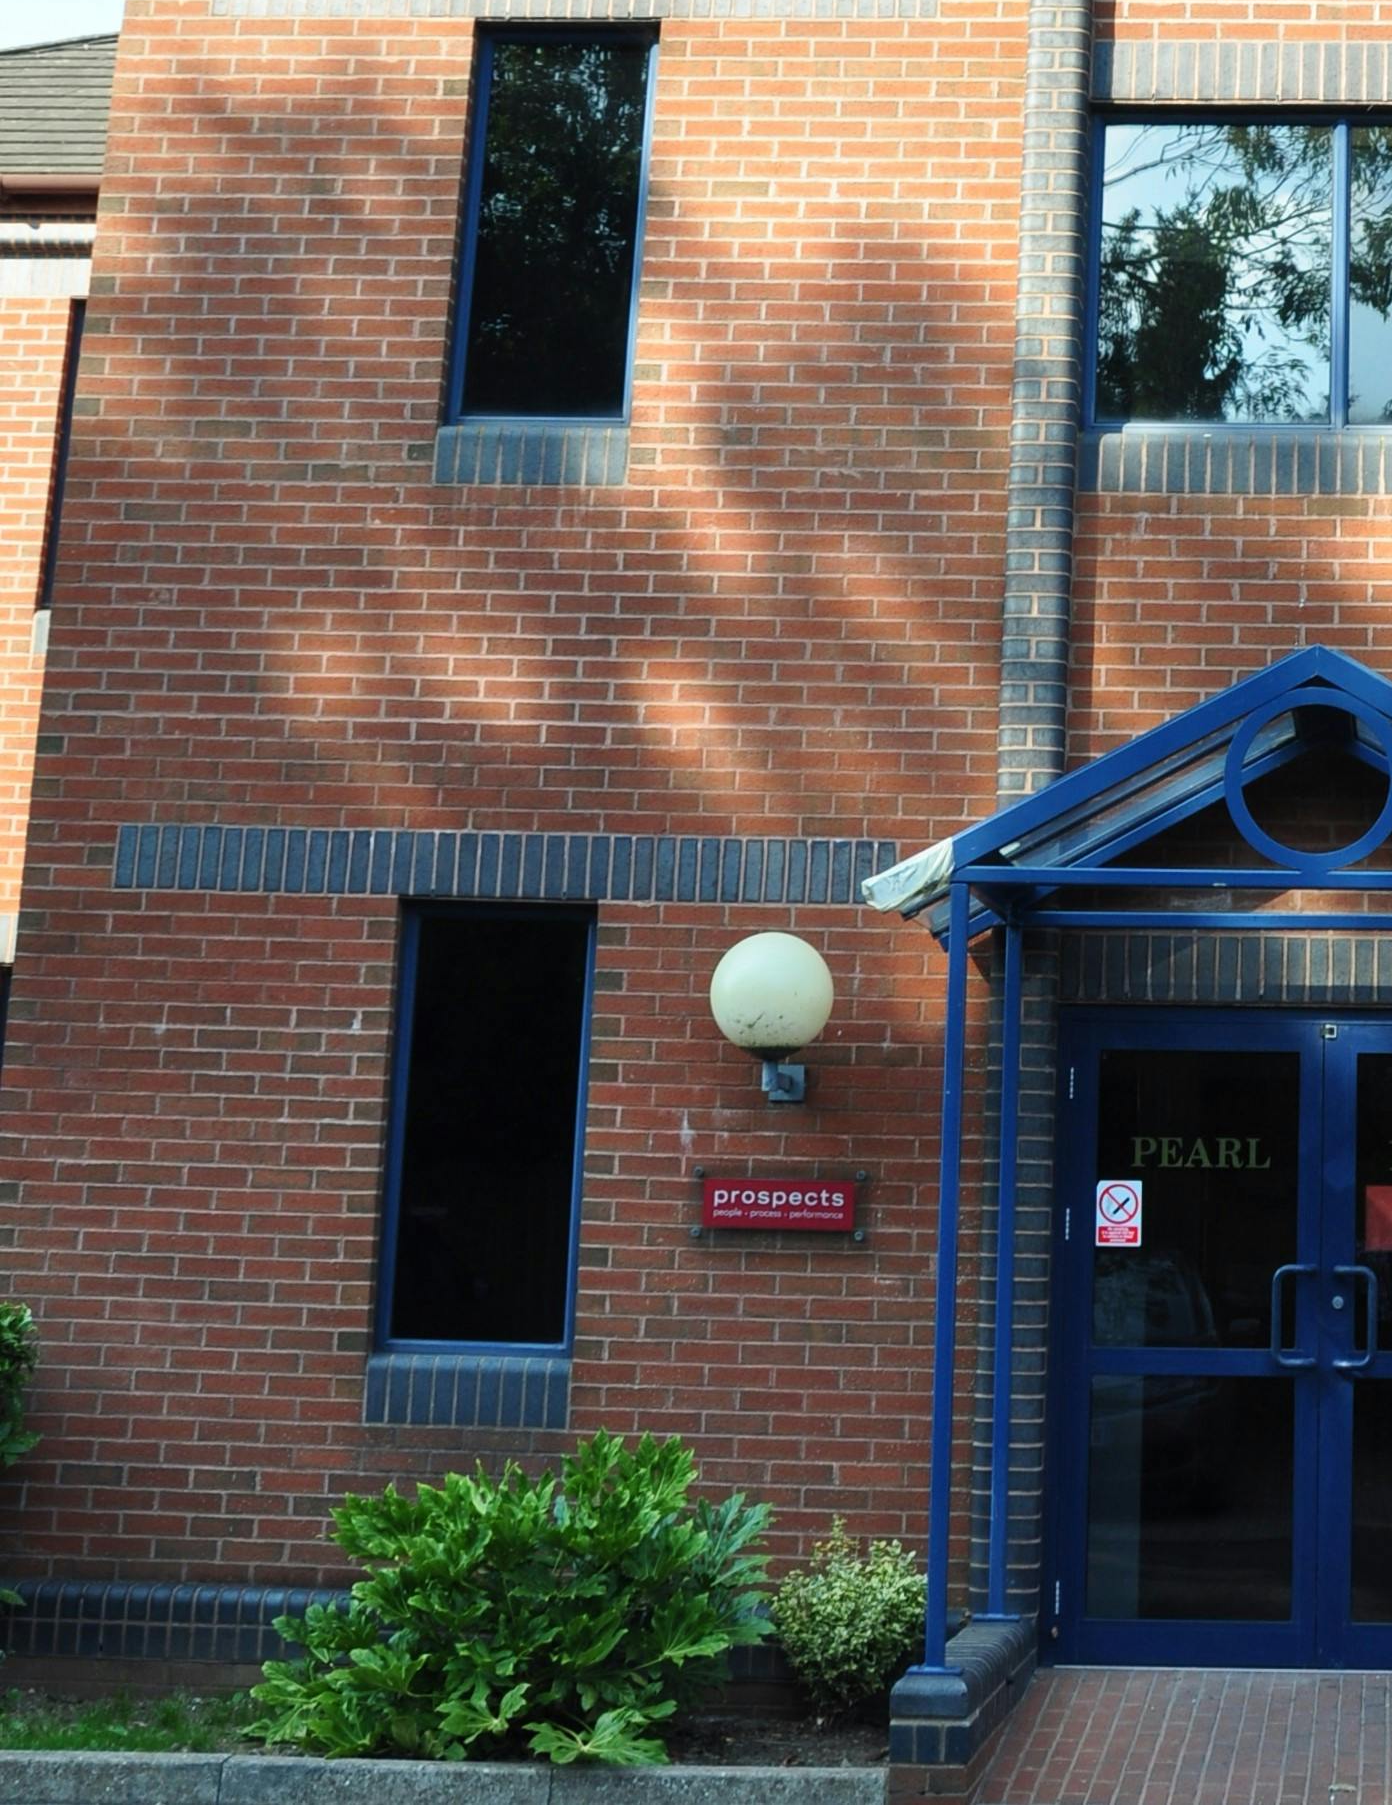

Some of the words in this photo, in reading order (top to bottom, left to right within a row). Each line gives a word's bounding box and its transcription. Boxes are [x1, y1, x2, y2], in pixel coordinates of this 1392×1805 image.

[1130, 1136, 1271, 1169] PEARL
[713, 1189, 845, 1208] prospects
[713, 1208, 742, 1218] people
[750, 1210, 782, 1219] process
[789, 1209, 843, 1220] performance
